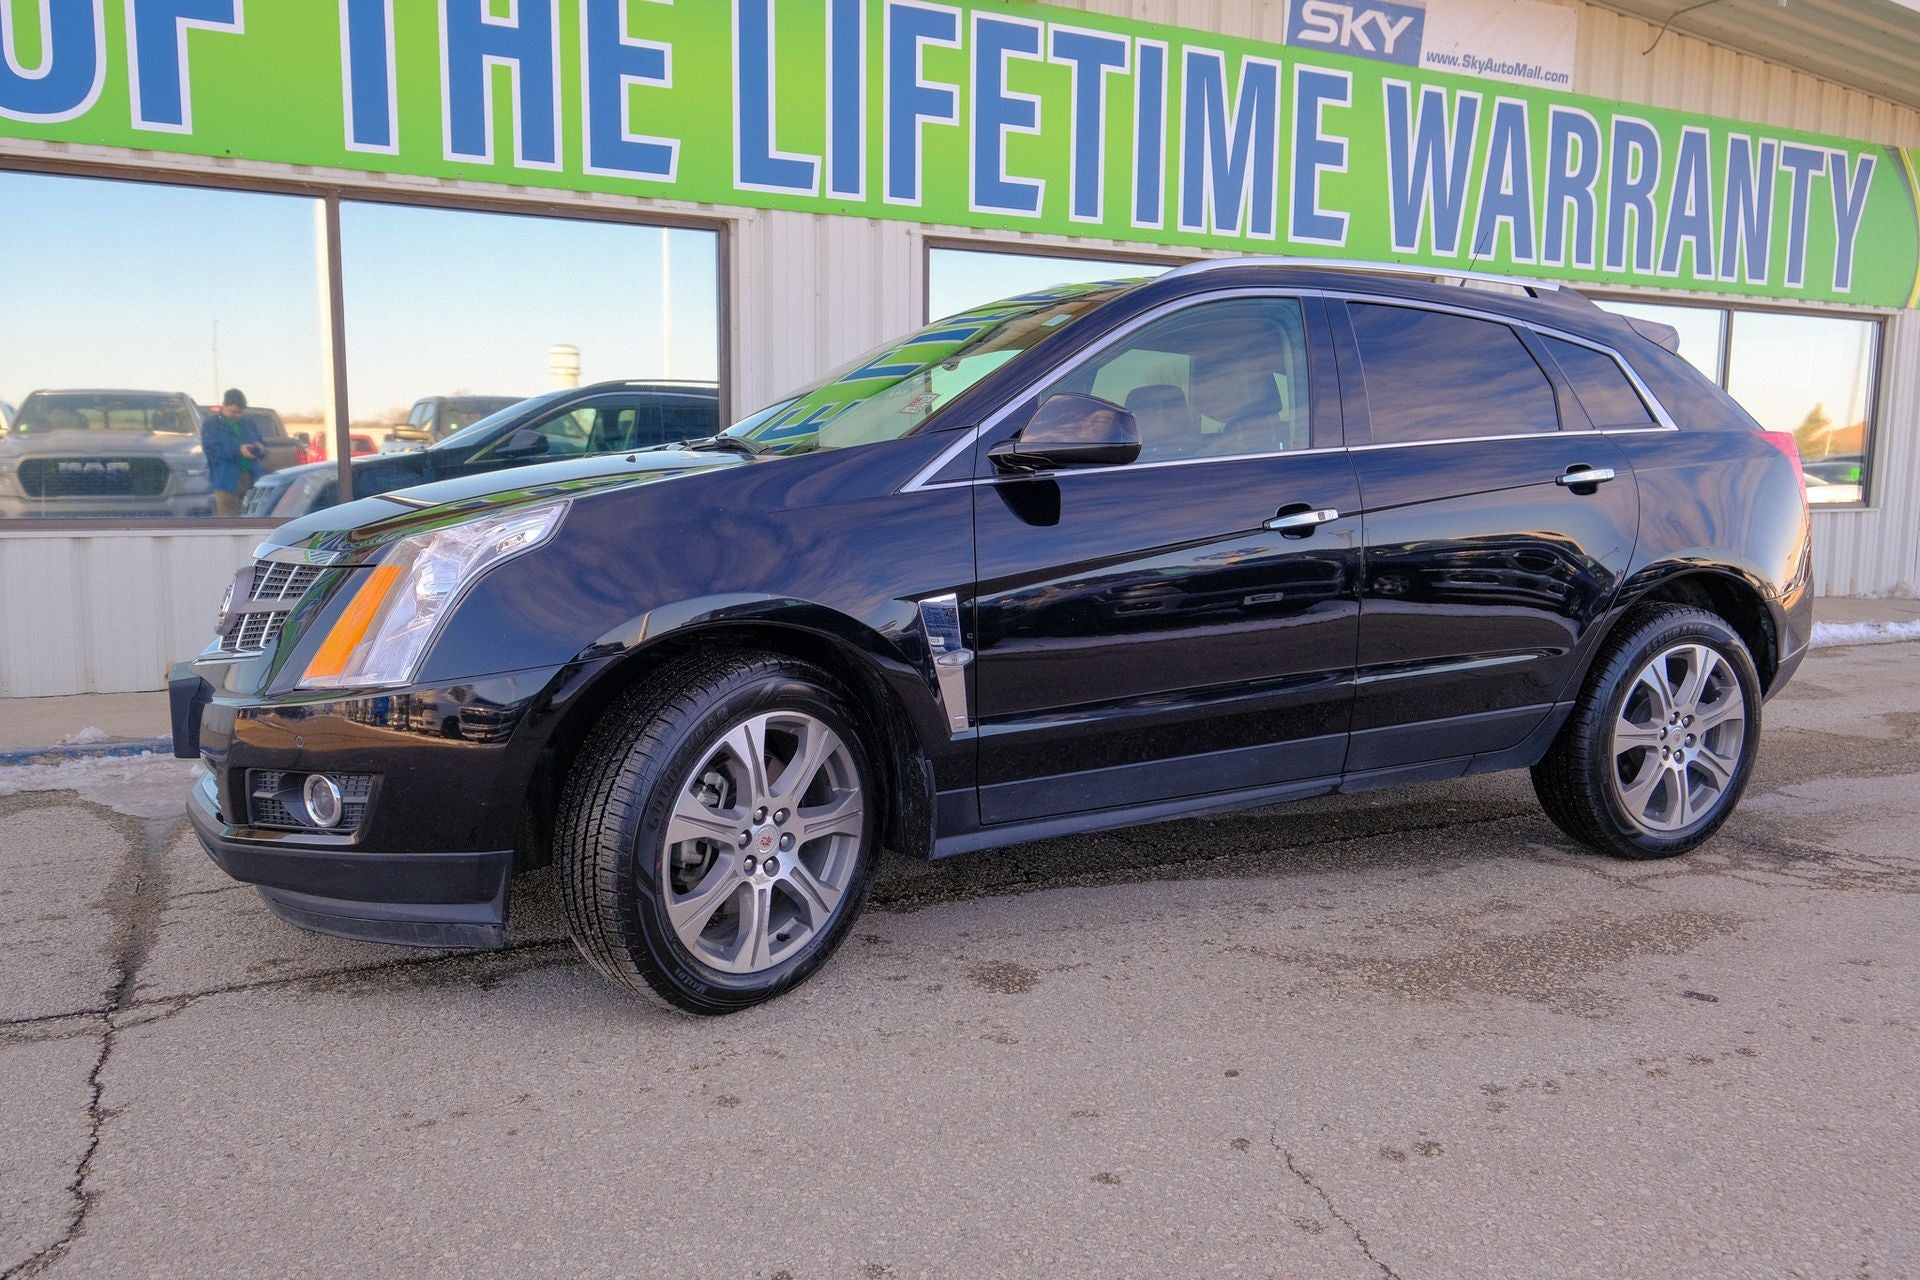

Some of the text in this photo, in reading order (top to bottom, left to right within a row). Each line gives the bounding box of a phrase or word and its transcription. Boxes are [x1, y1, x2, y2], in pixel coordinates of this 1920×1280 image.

[1297, 2, 1415, 54] SKY
[1426, 50, 1569, 84] www.SkyAutoMall.com
[732, 0, 1353, 248] LIFETIME
[1382, 78, 1878, 293] WARRANTY
